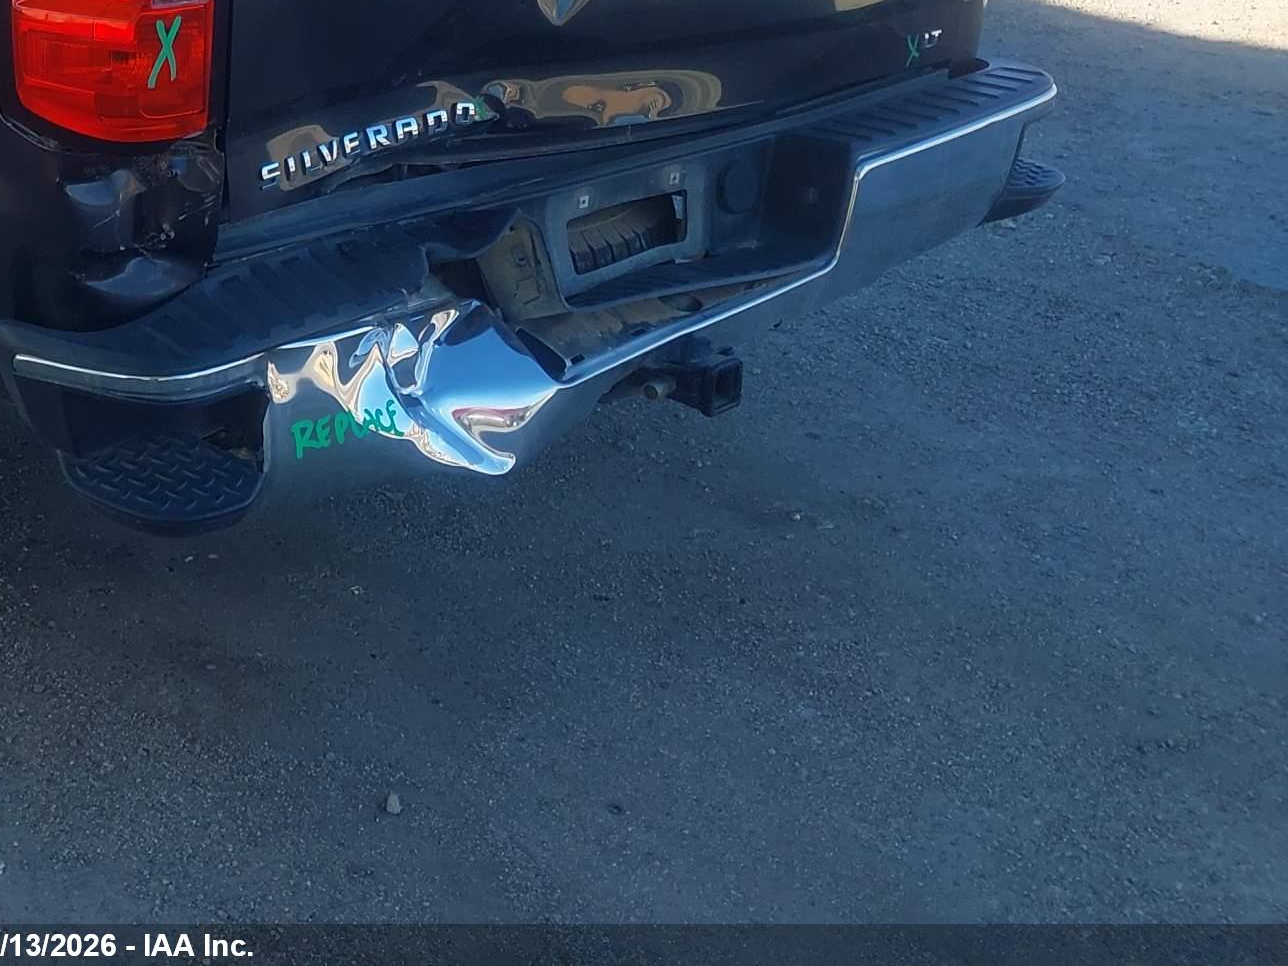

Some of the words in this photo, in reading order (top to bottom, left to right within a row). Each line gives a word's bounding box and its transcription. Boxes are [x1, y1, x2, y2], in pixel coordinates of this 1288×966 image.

[147, 15, 182, 89] X
[924, 29, 943, 48] LT
[261, 102, 476, 190] SILVERADO
[290, 399, 404, 459] REPLACE
